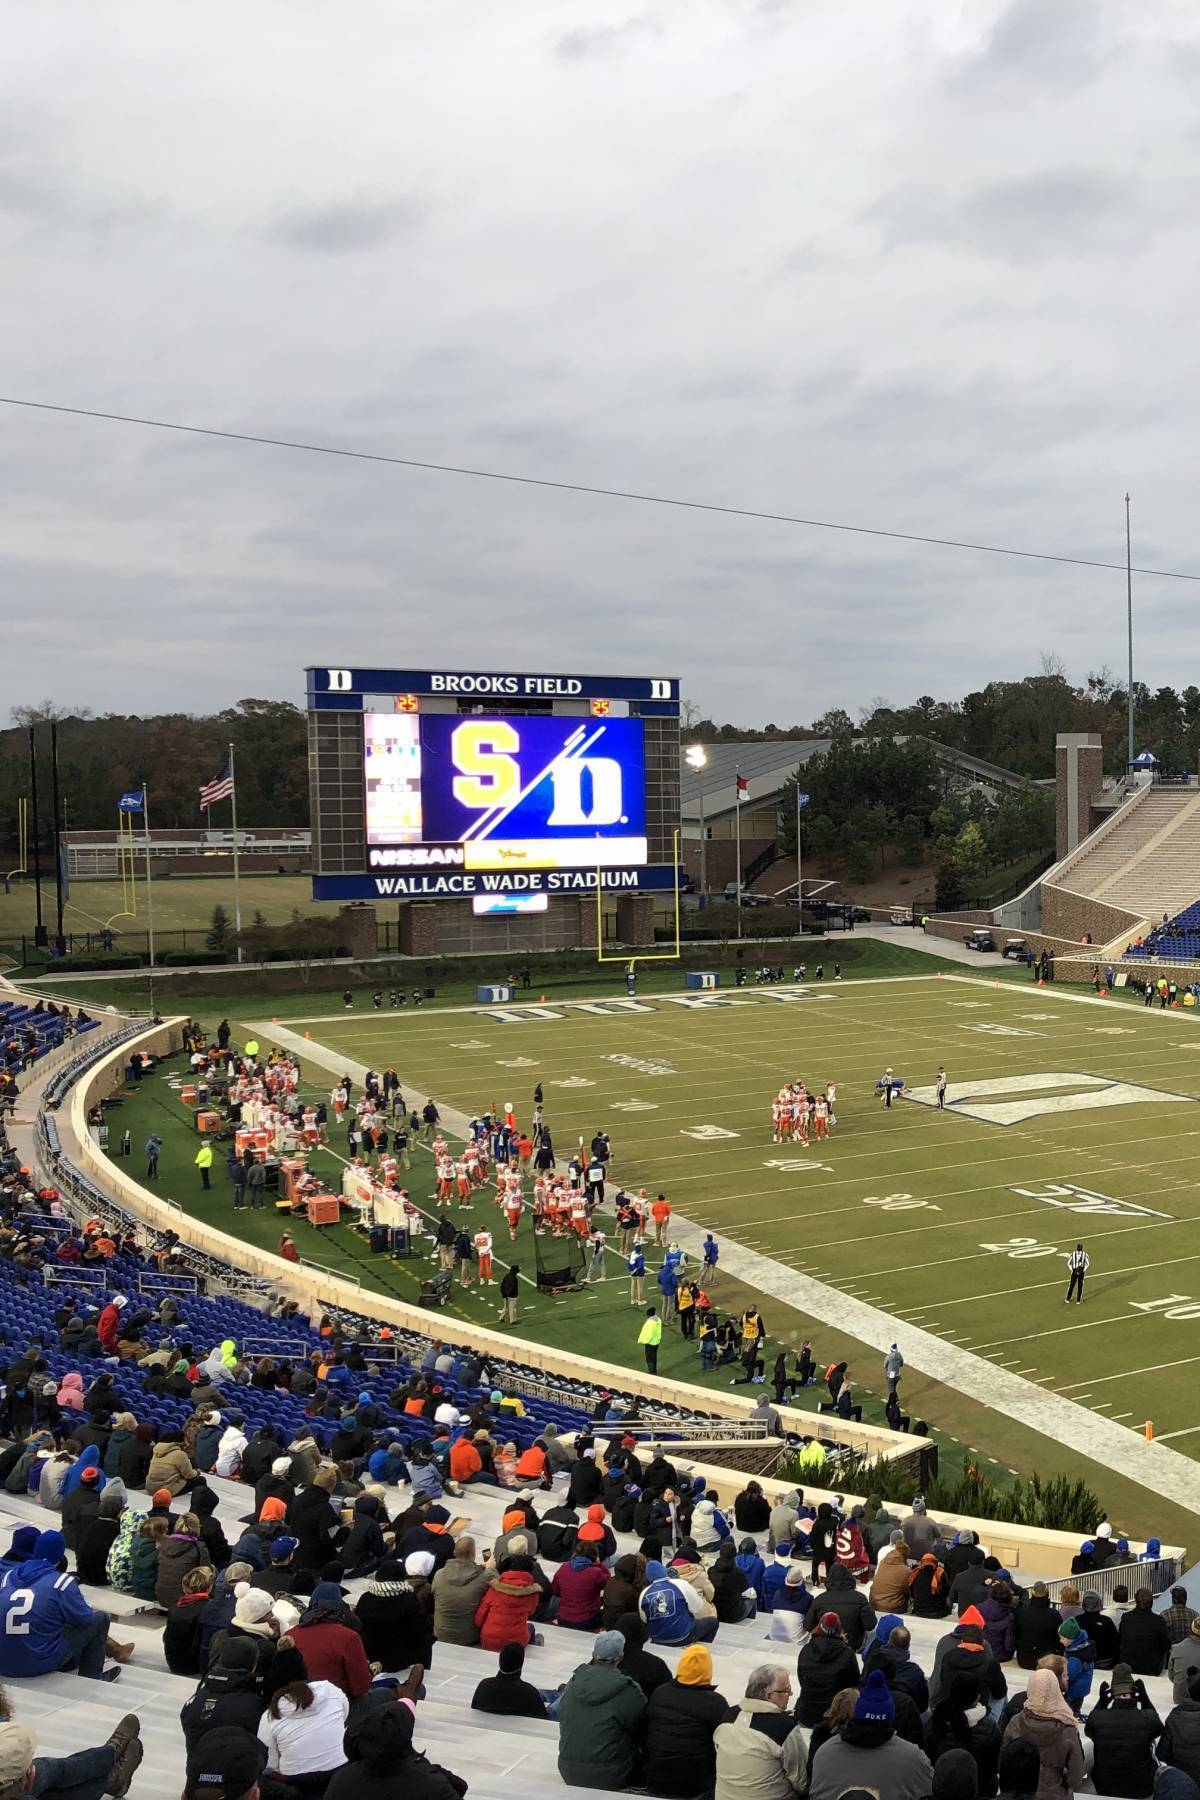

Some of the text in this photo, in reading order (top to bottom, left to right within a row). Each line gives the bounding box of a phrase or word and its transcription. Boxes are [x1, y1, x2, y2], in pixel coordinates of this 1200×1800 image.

[327, 669, 352, 691] D
[431, 674, 582, 695] BROOKS FIELD
[650, 679, 671, 699] D
[452, 720, 521, 808] S
[370, 847, 465, 867] NISSAN
[375, 871, 639, 894] WALLACE WADE STADIUM
[473, 987, 847, 1023] DUKE
[762, 1158, 824, 1172] 40
[862, 1193, 929, 1211] 30
[978, 1237, 1058, 1259] 20
[5, 1588, 35, 1635] 2
